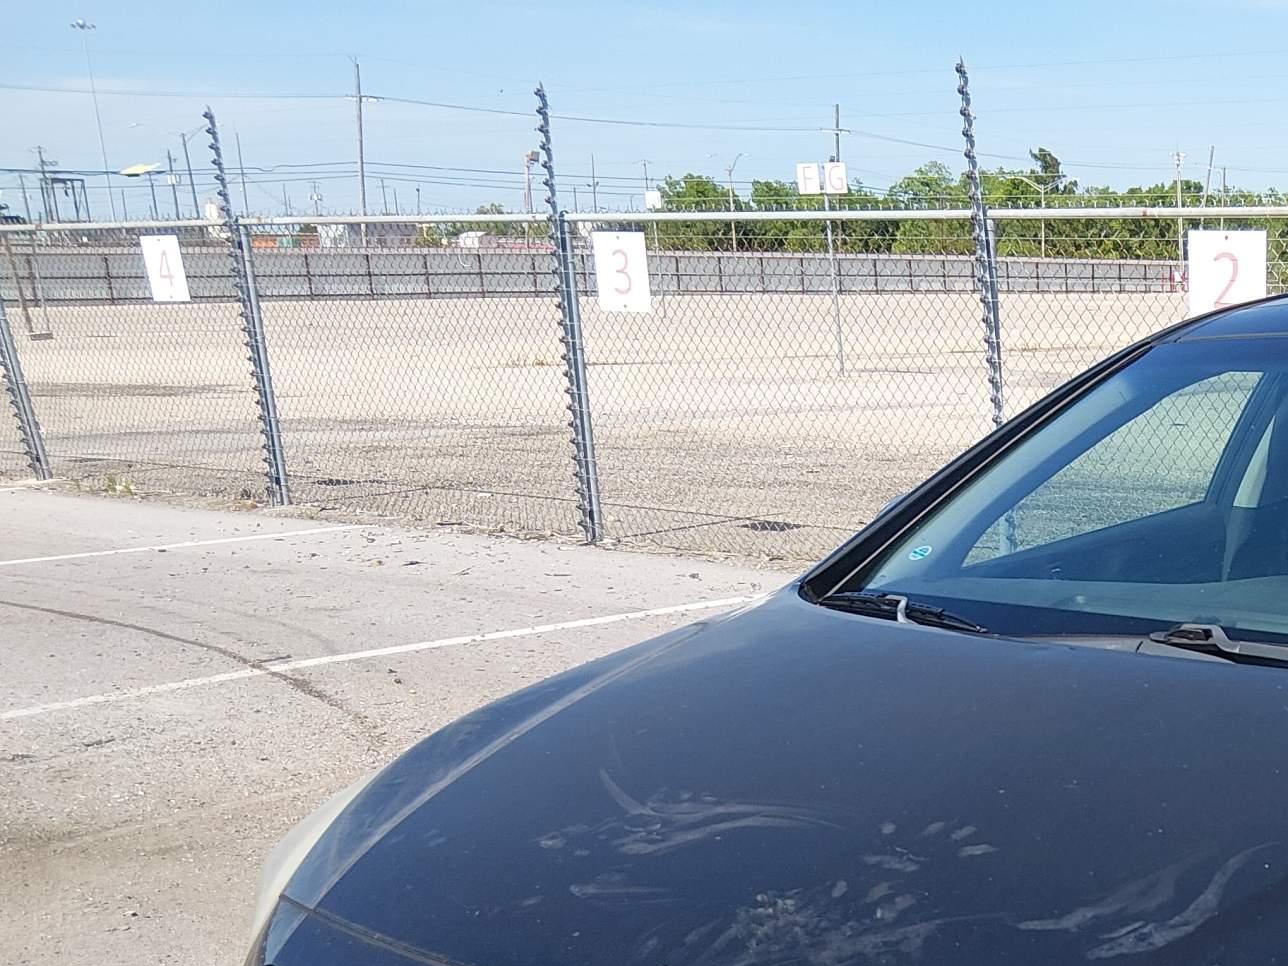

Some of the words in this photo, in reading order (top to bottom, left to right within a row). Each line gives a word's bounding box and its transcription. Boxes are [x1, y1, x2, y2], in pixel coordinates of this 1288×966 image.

[802, 165, 814, 192] F
[828, 165, 844, 191] G
[160, 249, 175, 287] 4
[611, 249, 632, 295] 3
[1213, 251, 1239, 309] 2
